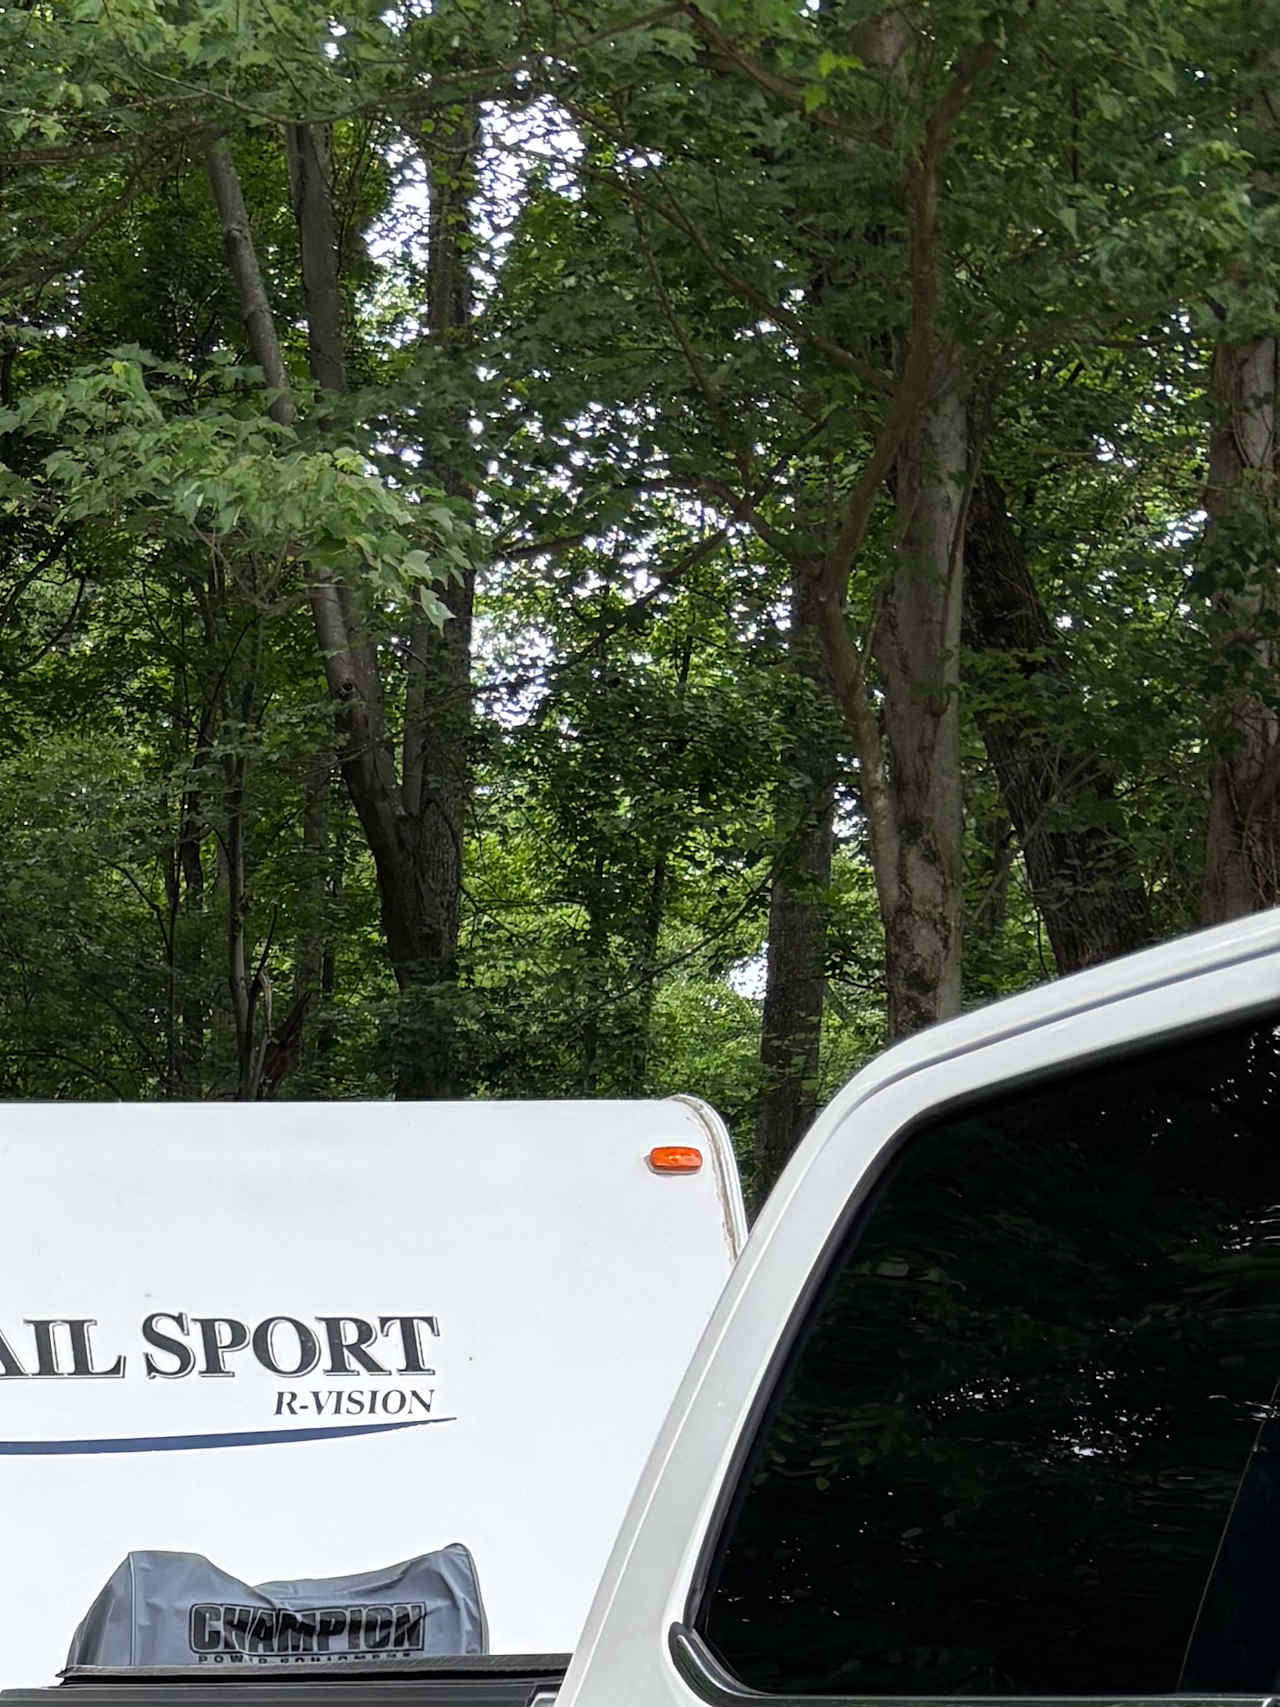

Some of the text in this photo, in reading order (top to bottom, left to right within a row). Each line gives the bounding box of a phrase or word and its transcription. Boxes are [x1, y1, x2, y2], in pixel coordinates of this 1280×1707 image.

[142, 1312, 441, 1379] SPORT
[273, 1388, 436, 1416] R-VISION
[190, 1601, 426, 1656] CHAMPION
